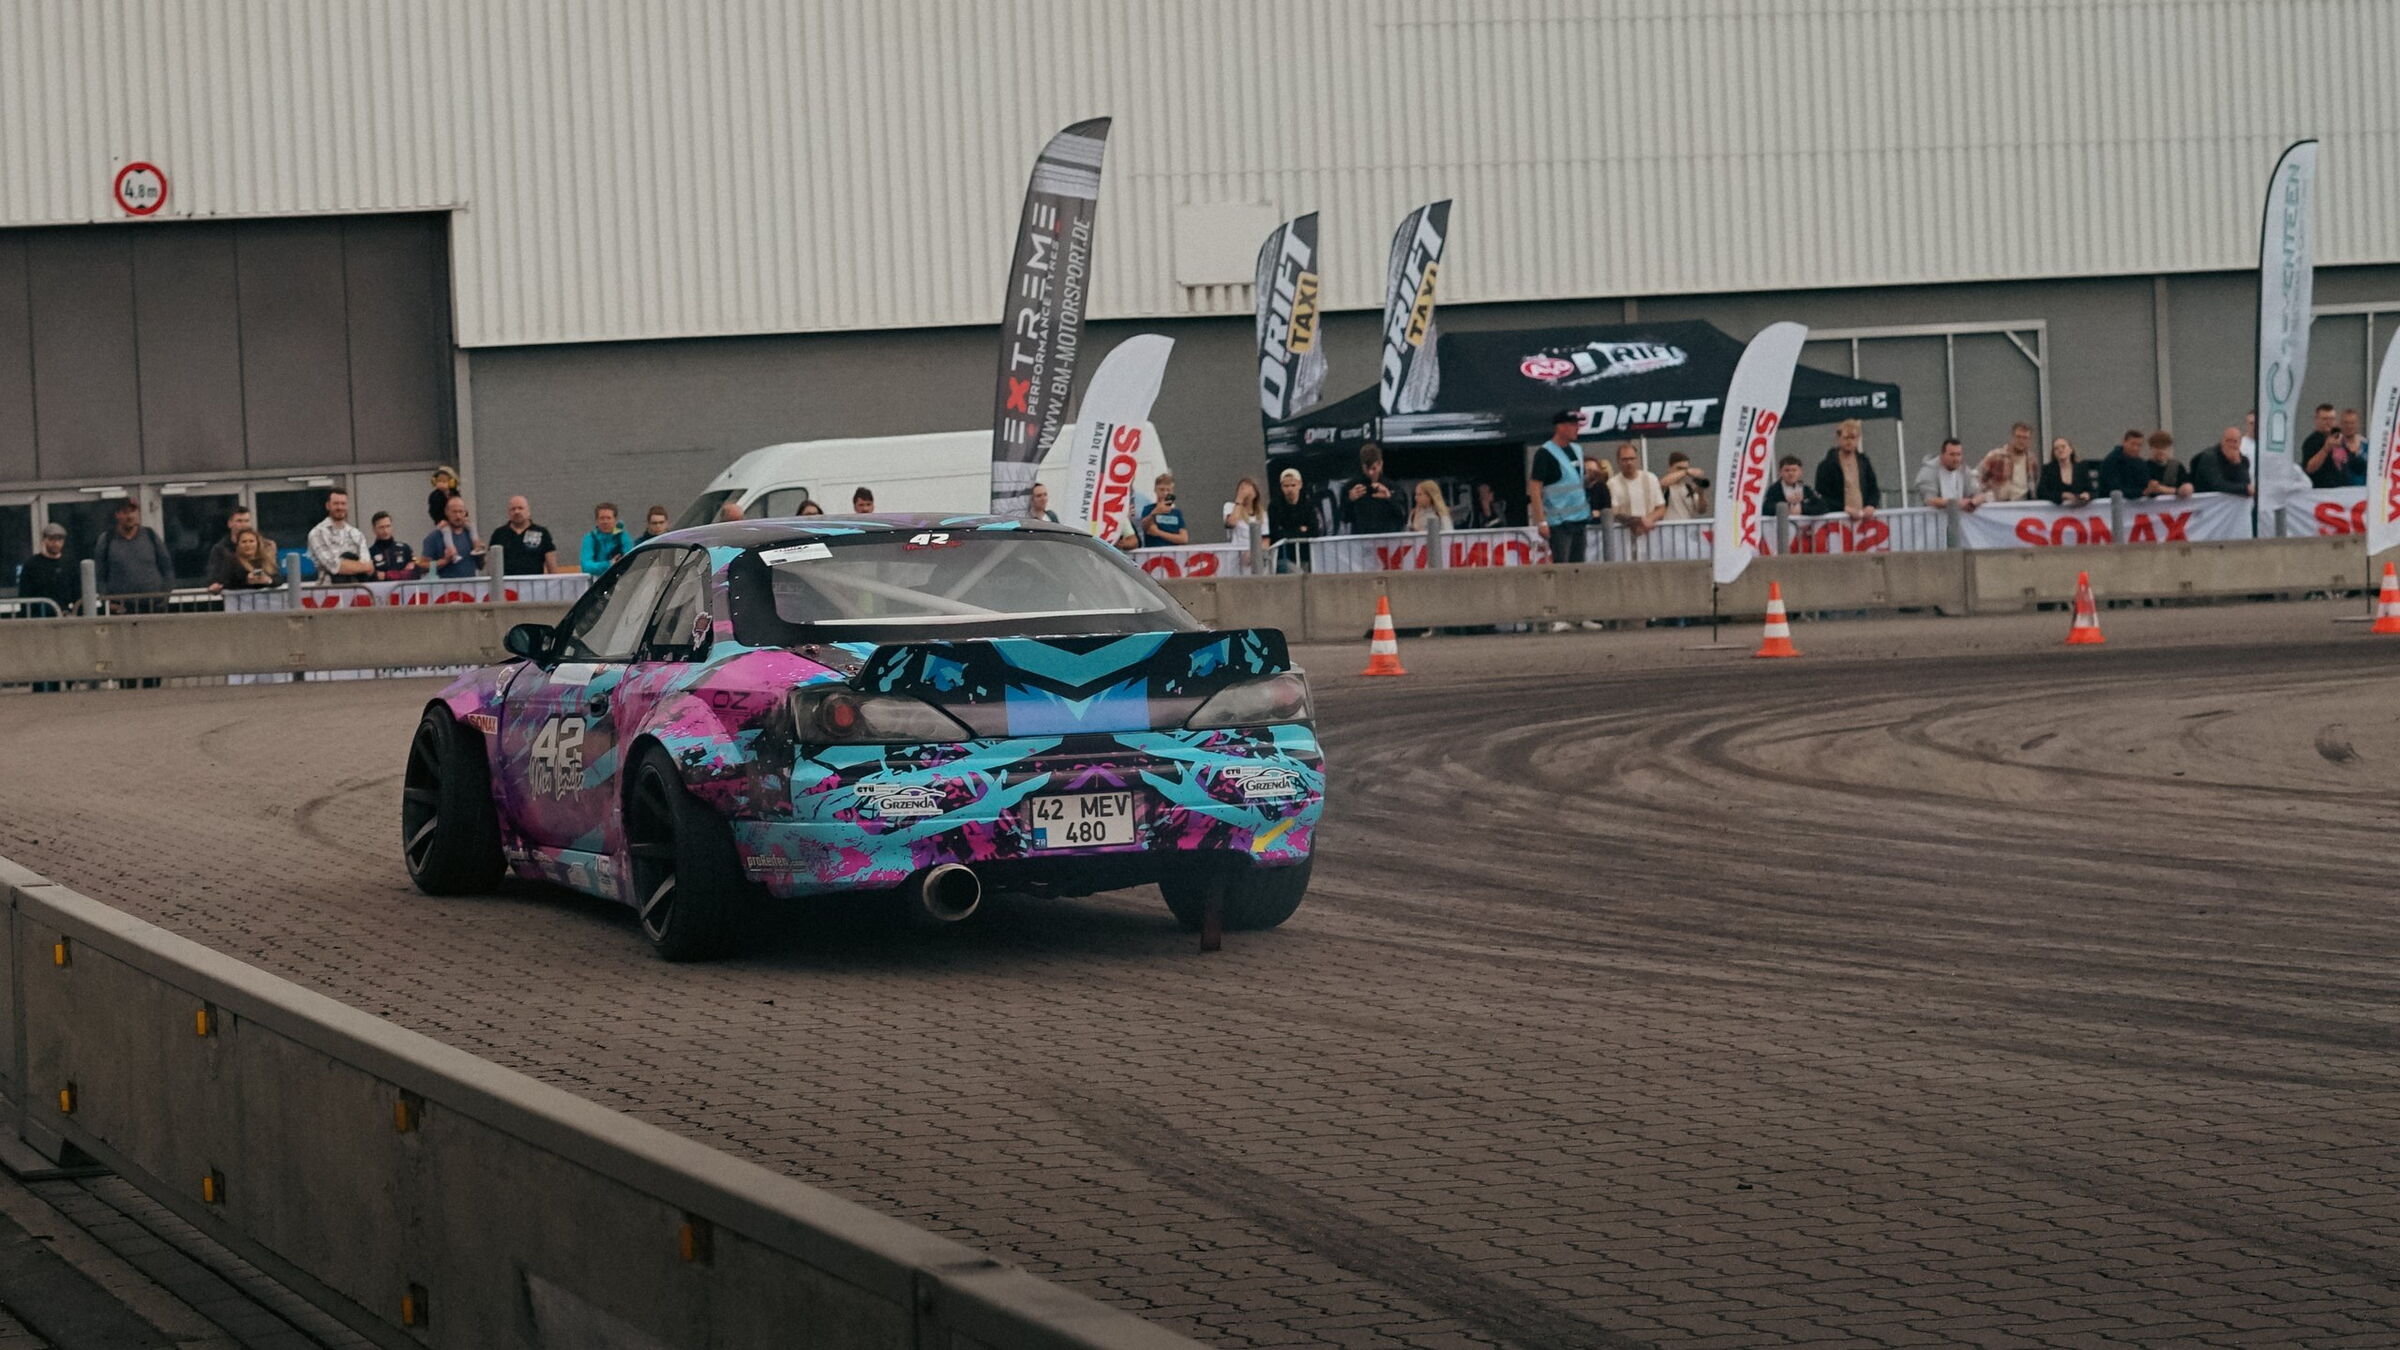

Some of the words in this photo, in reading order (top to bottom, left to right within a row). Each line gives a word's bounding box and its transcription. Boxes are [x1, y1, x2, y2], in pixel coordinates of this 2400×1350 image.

[1003, 203, 1056, 444] EXTREME
[1037, 216, 1090, 450] WWW.BM-MOTORSPORT.DE
[1260, 219, 1311, 420] DRIFT
[1290, 277, 1318, 348] TAXI
[1380, 204, 1443, 415] DRIFT
[1027, 298, 1053, 416] PERFORMANCE
[1091, 421, 1105, 450] MADE
[1577, 398, 1719, 435] DRIFT
[1087, 454, 1098, 466] IN
[1100, 424, 1142, 546] SONA
[1740, 409, 1779, 548] SONAX
[1079, 470, 1096, 521] GERMANY
[909, 533, 950, 546] 42
[531, 716, 586, 769] 42
[1037, 799, 1064, 821] 42
[1080, 794, 1130, 818] MEV
[1066, 820, 1106, 843] 480
